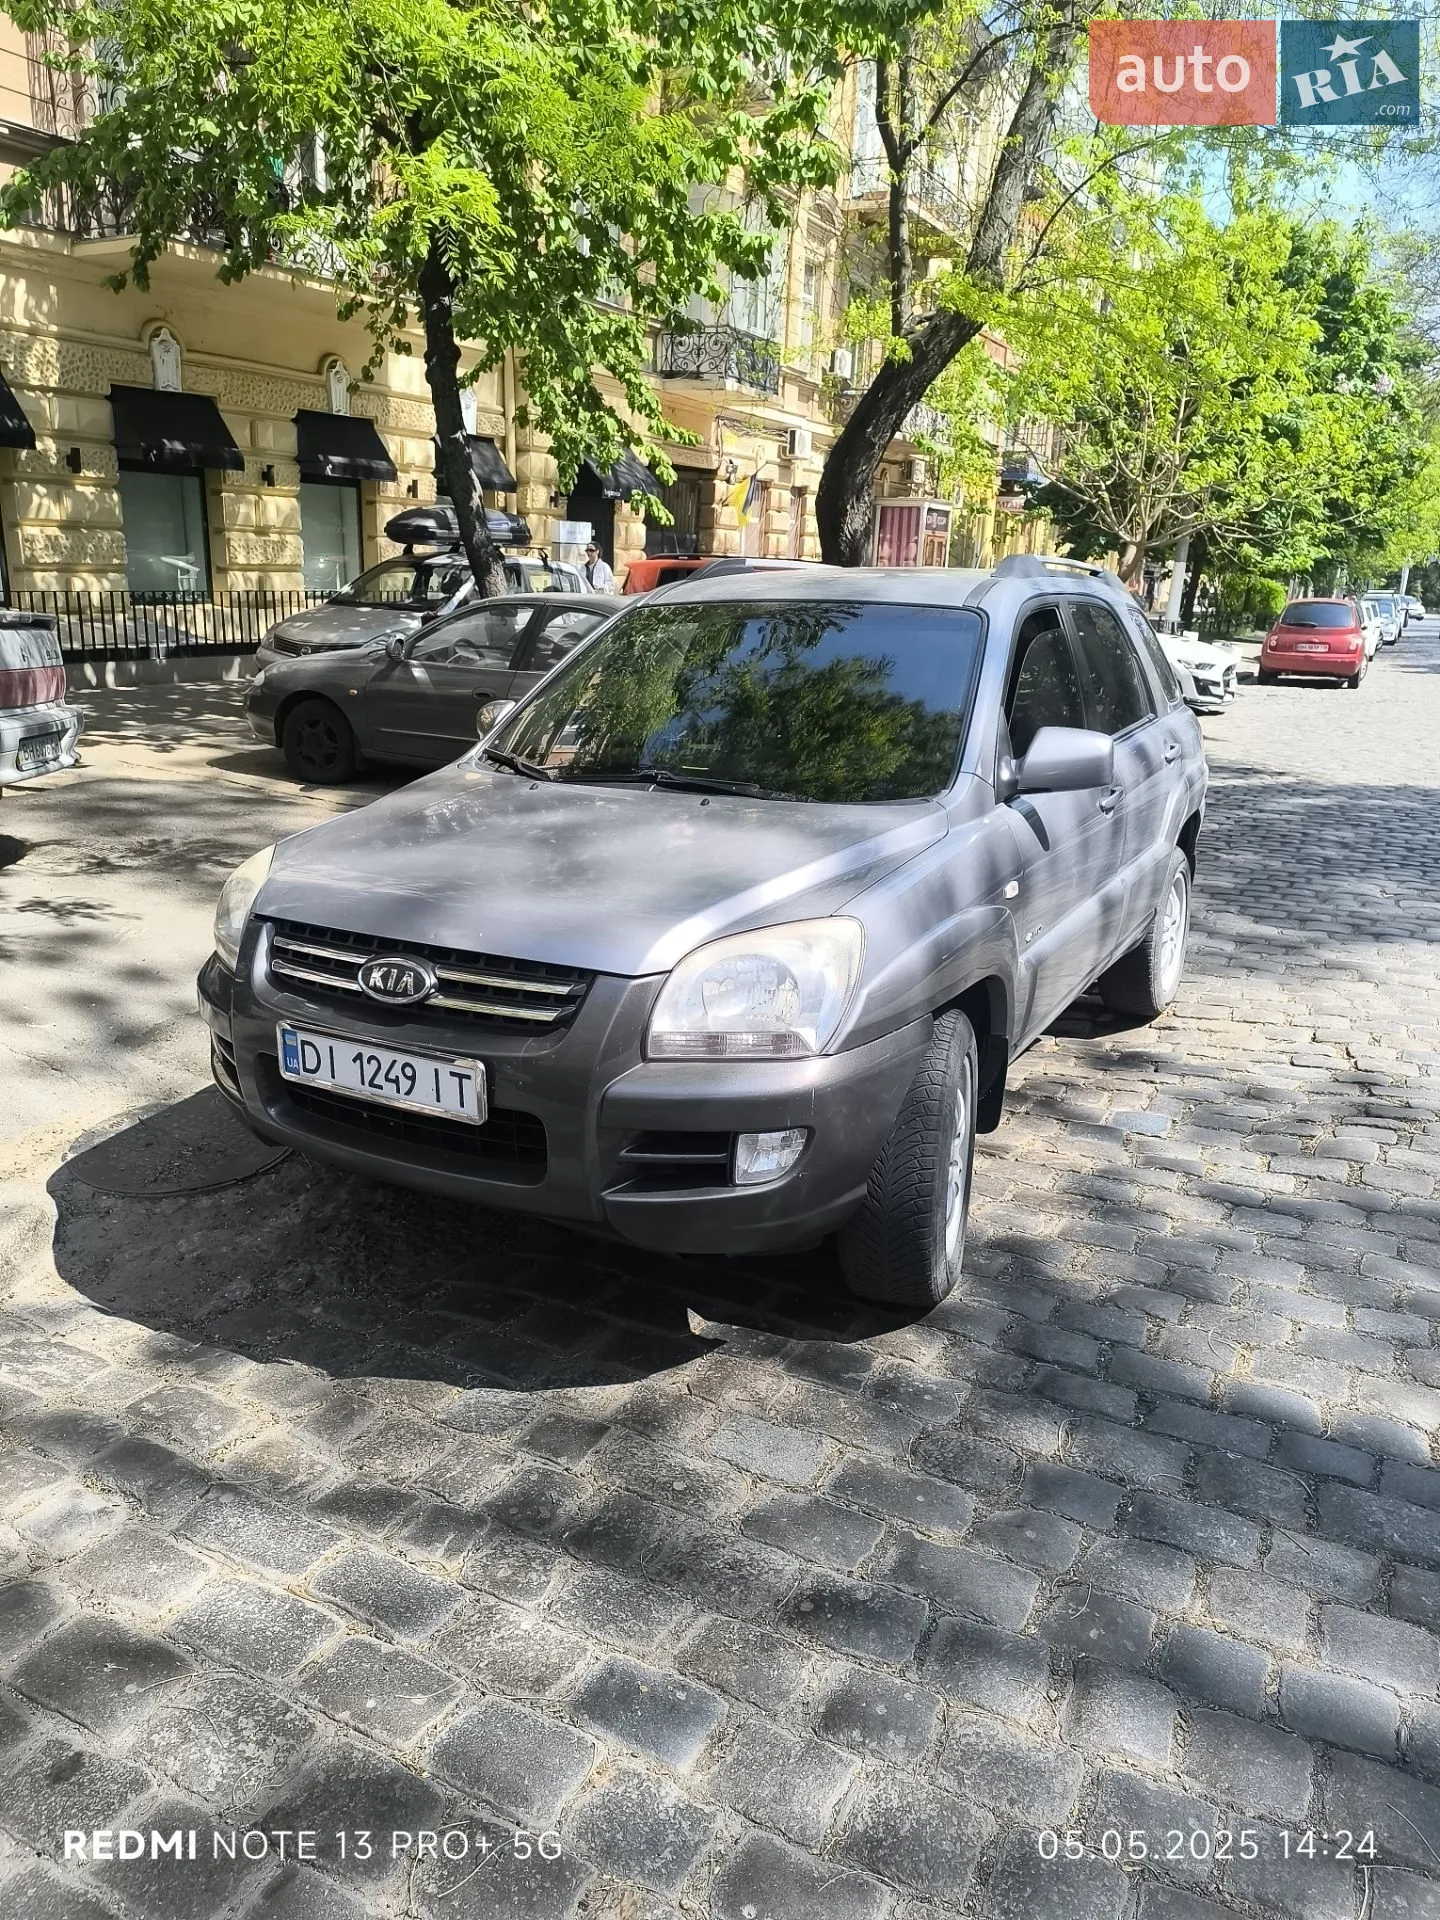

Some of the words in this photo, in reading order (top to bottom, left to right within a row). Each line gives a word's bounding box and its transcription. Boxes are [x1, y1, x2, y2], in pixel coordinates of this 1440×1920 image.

[368, 965, 414, 995] KIA
[286, 1057, 300, 1069] UA
[300, 1039, 336, 1080] DI
[352, 1052, 417, 1096] 1249
[434, 1068, 472, 1109] IT
